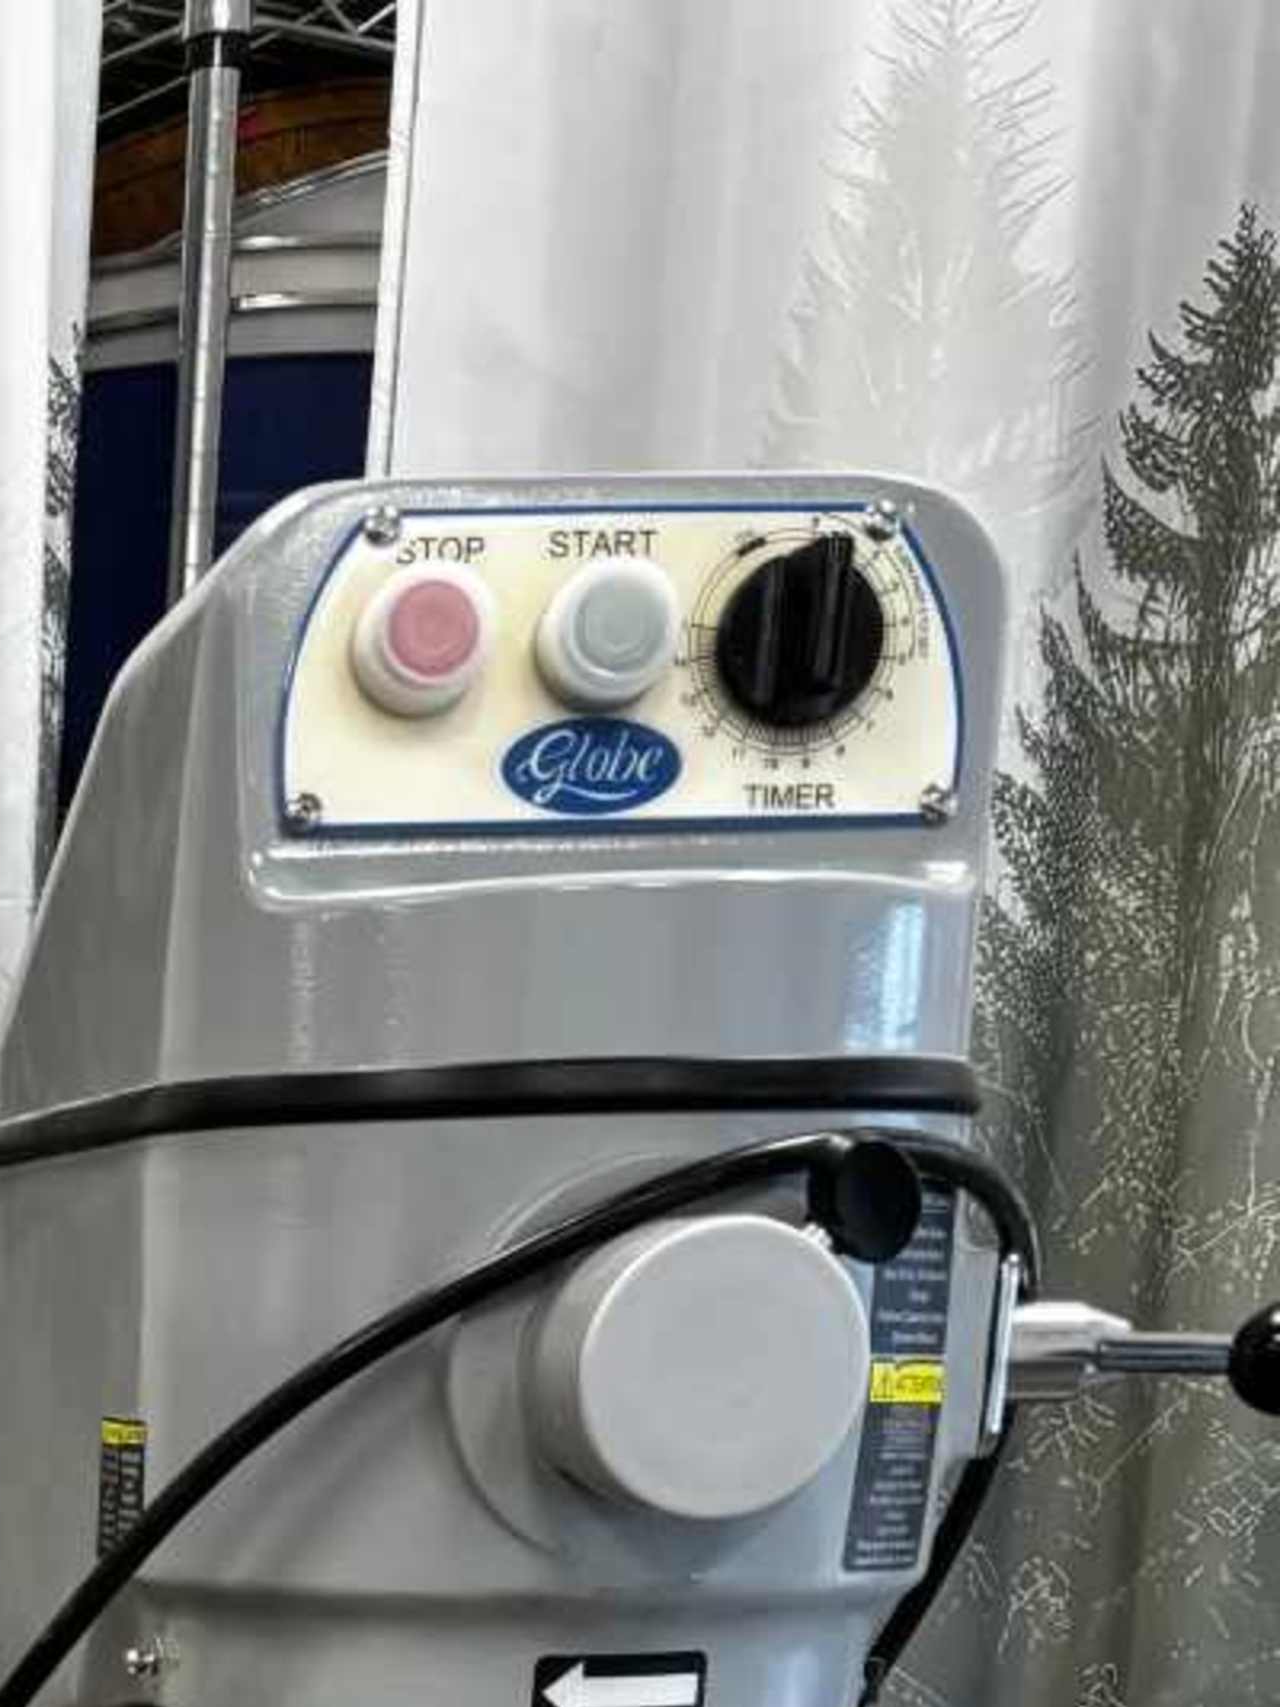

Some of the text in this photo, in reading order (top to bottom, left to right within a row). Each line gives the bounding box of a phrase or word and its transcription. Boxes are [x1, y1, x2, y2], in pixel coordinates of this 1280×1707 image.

[396, 535, 486, 565] STOP
[548, 529, 658, 559] START
[512, 727, 665, 805] Globe
[742, 783, 836, 810] TIMER
